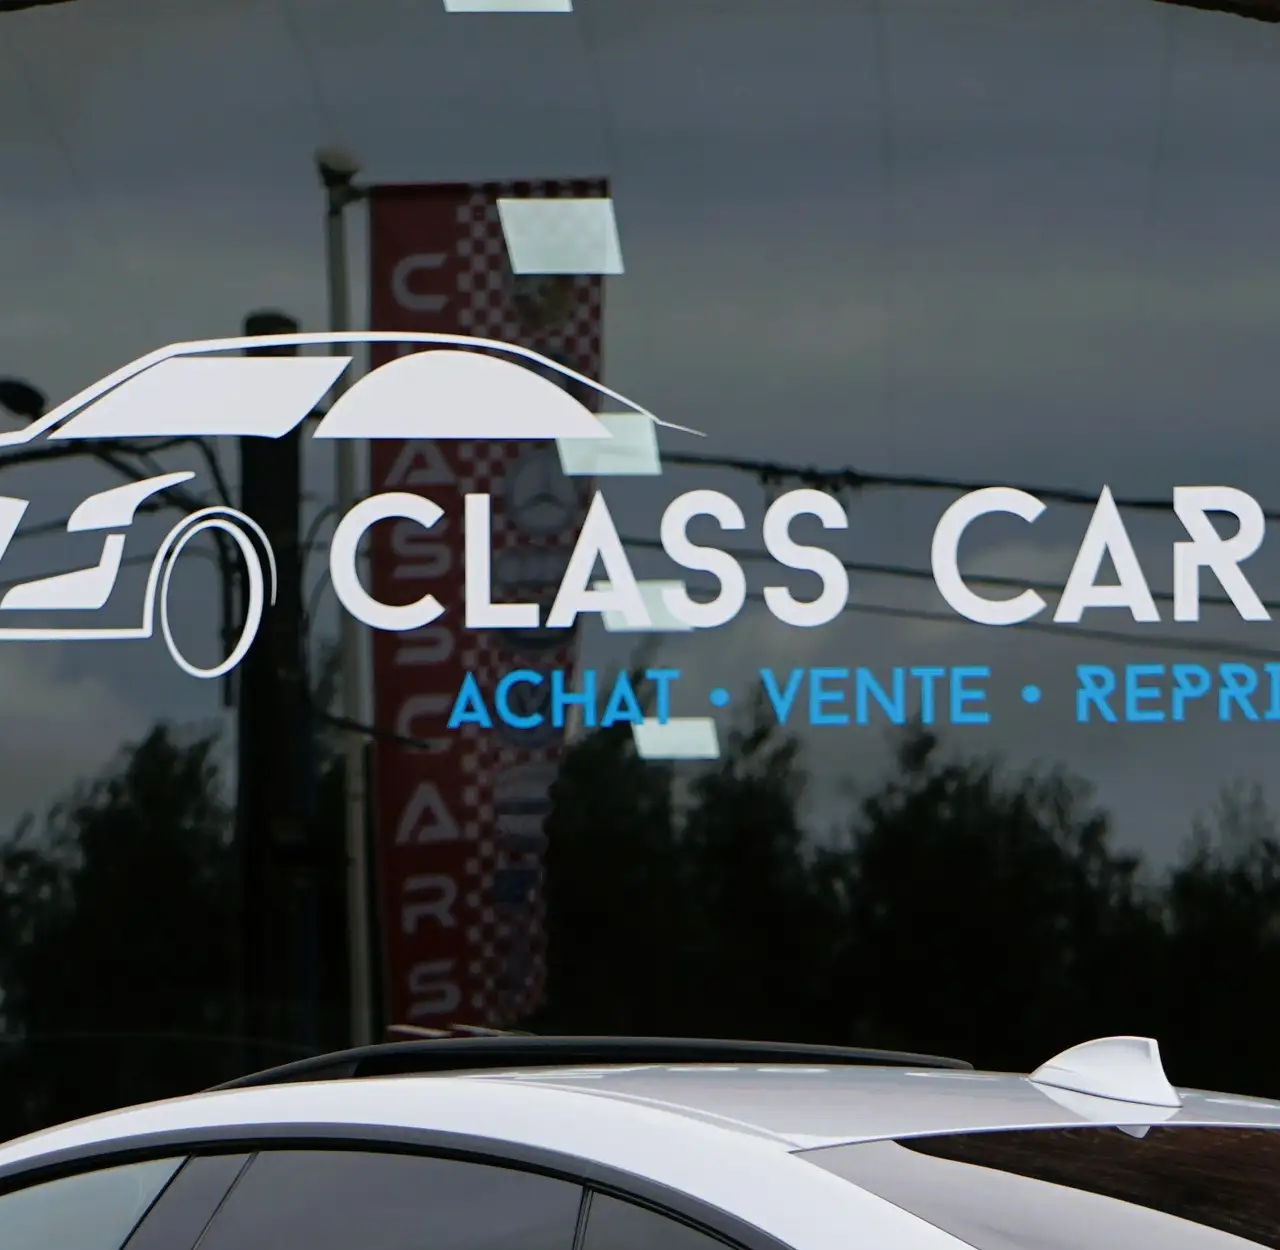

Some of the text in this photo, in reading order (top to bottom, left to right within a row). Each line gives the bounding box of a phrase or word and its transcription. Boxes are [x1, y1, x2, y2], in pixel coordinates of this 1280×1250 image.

[330, 489, 848, 630] CLASS
[384, 252, 462, 1016] CASSCARS
[448, 669, 682, 728] ACHAT
[759, 666, 991, 726] VENTE
